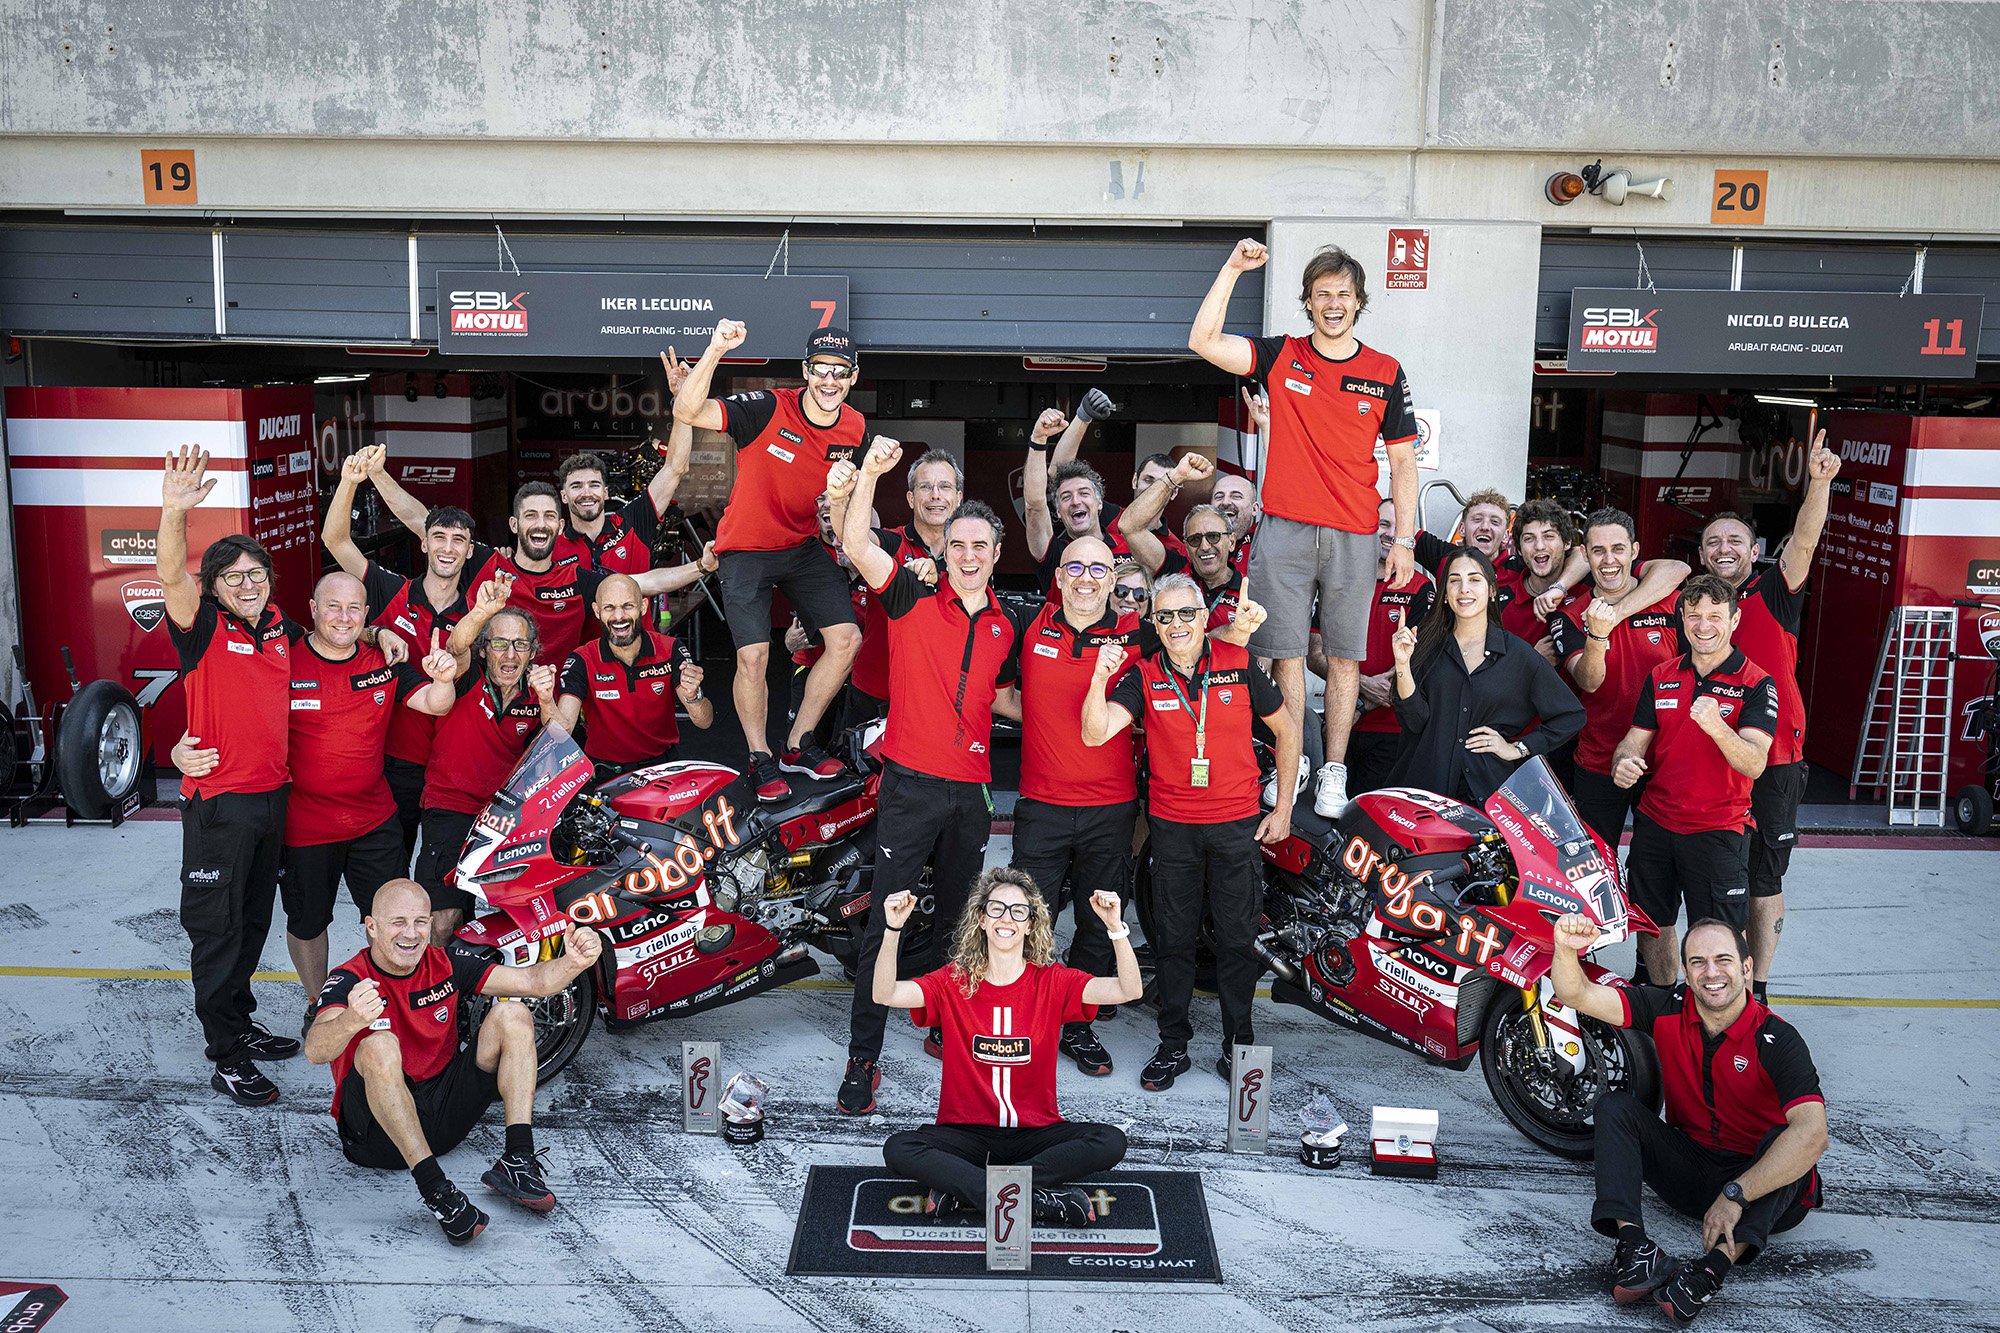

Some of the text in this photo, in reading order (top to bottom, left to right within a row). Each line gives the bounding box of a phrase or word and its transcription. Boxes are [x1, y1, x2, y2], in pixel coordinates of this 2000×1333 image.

[149, 162, 191, 191] 19
[1717, 182, 1760, 211] 20
[1388, 280, 1425, 288] EXTINTOR
[450, 291, 528, 310] SBK
[601, 298, 713, 311] IKER LECUONA
[455, 313, 524, 329] MOTUL
[810, 301, 837, 328] 7
[1583, 308, 1660, 327] SBK
[1727, 314, 1850, 329] NICOLO BULEGA
[643, 327, 676, 335] RACING
[1584, 329, 1654, 346] MOTUL
[1920, 318, 1967, 356] 11
[1770, 343, 1803, 353] RACING
[1811, 343, 1843, 353] DUCATI
[259, 415, 301, 441] DUCATI
[780, 429, 802, 444] Lenovo
[521, 451, 551, 459] Lenovo
[1840, 439, 1891, 467] DUCATI
[253, 462, 274, 476] Lenovo
[558, 554, 578, 565] Lenovo
[127, 588, 165, 597] DUCATI
[540, 587, 574, 600] aruba.it
[134, 609, 161, 618] CORSE
[1090, 634, 1129, 645] aruba.it
[357, 670, 393, 688] aruba.it
[639, 663, 672, 677] aruba.it
[133, 669, 181, 707] 7
[291, 681, 317, 689] Lenovo
[551, 780, 576, 803] riello
[669, 789, 699, 802] DUCATI
[1388, 811, 1417, 830] DUCATI
[503, 828, 549, 846] ALTEN
[1498, 812, 1523, 837] riello
[1521, 836, 1535, 852] ups
[497, 841, 542, 863] Lenovo
[566, 795, 741, 924] aruba.it
[828, 852, 861, 874] DAMAST
[1525, 870, 1576, 893] ALTEN
[1343, 836, 1504, 965] aruba.it
[1528, 884, 1579, 912] Lenovo
[532, 898, 548, 922] Dierre
[646, 925, 698, 954] riello ups
[643, 948, 696, 982] STULZ
[1513, 944, 1536, 968] Dierre
[1385, 961, 1416, 986] riello
[978, 1039, 1024, 1053] aruba.it
[1241, 1051, 1246, 1060] 1
[1312, 1151, 1320, 1165] 1
[902, 1228, 964, 1240] Ducati
[1059, 1230, 1107, 1241] Team
[1068, 1256, 1157, 1270] Ecology
